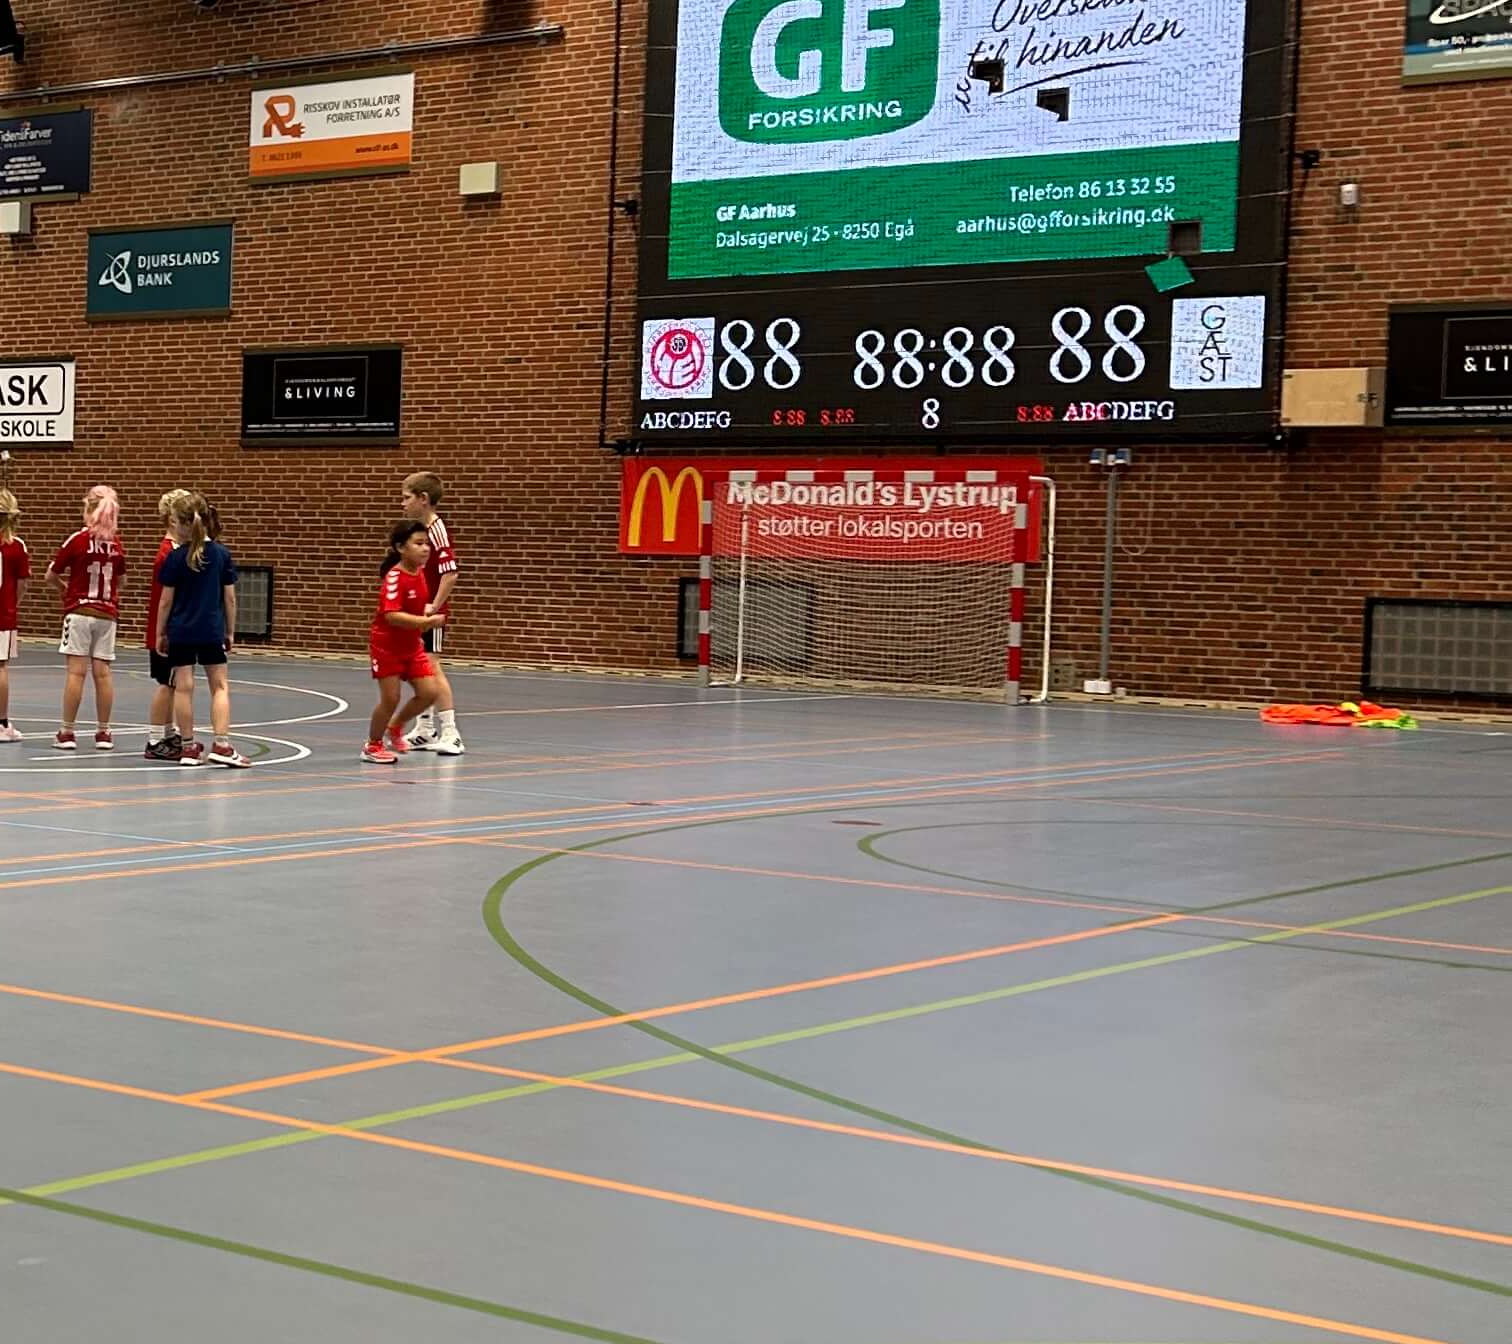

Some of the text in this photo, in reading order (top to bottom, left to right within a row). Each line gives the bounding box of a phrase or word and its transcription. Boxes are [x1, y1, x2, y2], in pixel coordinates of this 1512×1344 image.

[1016, 9, 1185, 68] hinanden
[303, 100, 341, 114] RISSKOV
[384, 107, 400, 119] A/S
[748, 99, 903, 130] FORSIKRING
[1009, 175, 1176, 203] Telefon 86 13 32 55
[716, 203, 796, 223] GF Aarhus
[716, 217, 915, 249] Dalsagervej 25 8250 Egå
[138, 251, 221, 271] DJURSLANDS
[137, 272, 174, 287] BANK
[718, 317, 803, 391] 88
[853, 325, 1016, 390] 88:88
[1049, 304, 1146, 384] 88
[640, 411, 732, 430] ABCDEFG
[921, 397, 941, 429] 8
[1062, 400, 1175, 422] ABCDEFG
[727, 480, 1018, 513] McDonald's Lystrup
[758, 515, 984, 544] støtter lokalsporten
[87, 561, 114, 600] 11
